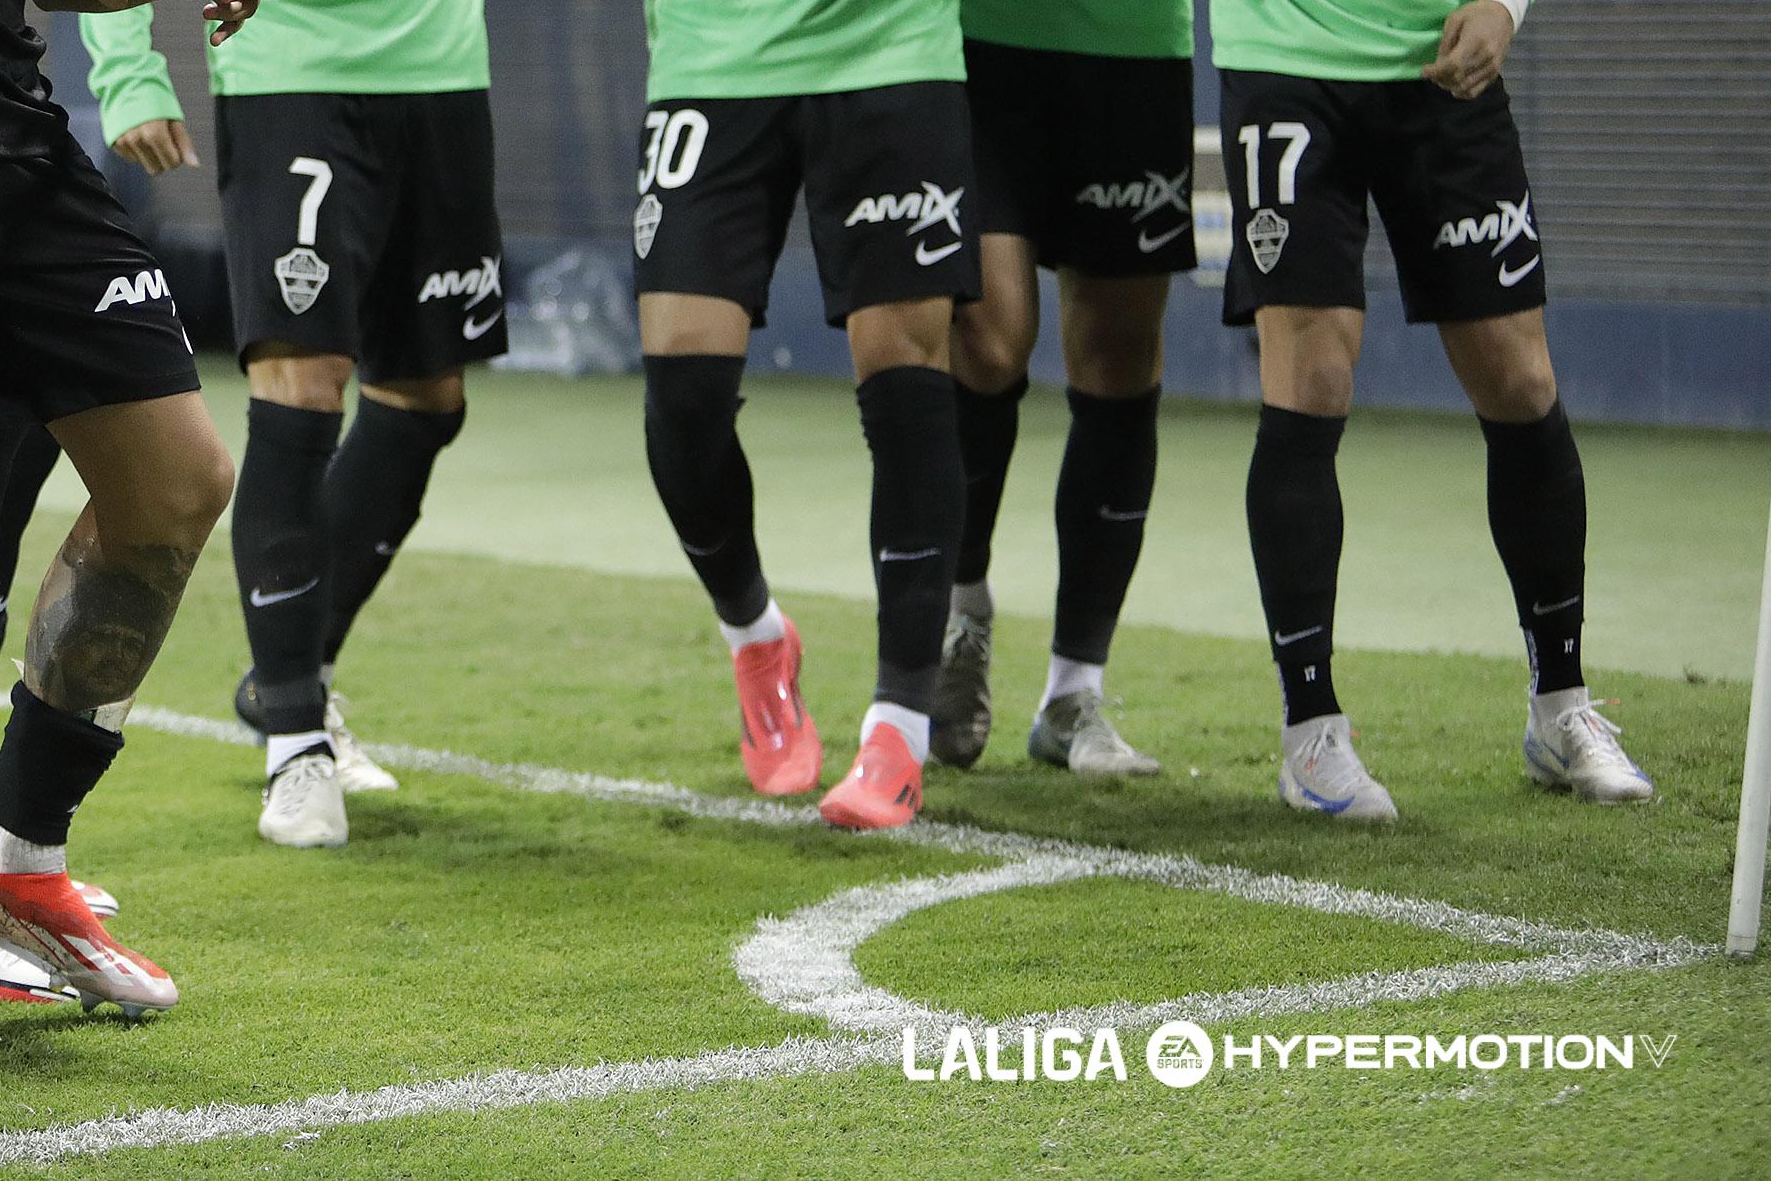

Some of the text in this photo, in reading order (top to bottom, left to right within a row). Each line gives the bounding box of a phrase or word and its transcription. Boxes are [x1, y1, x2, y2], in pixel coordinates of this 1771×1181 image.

[637, 109, 709, 195] 30
[1238, 122, 1311, 209] 17
[289, 156, 333, 246] 7
